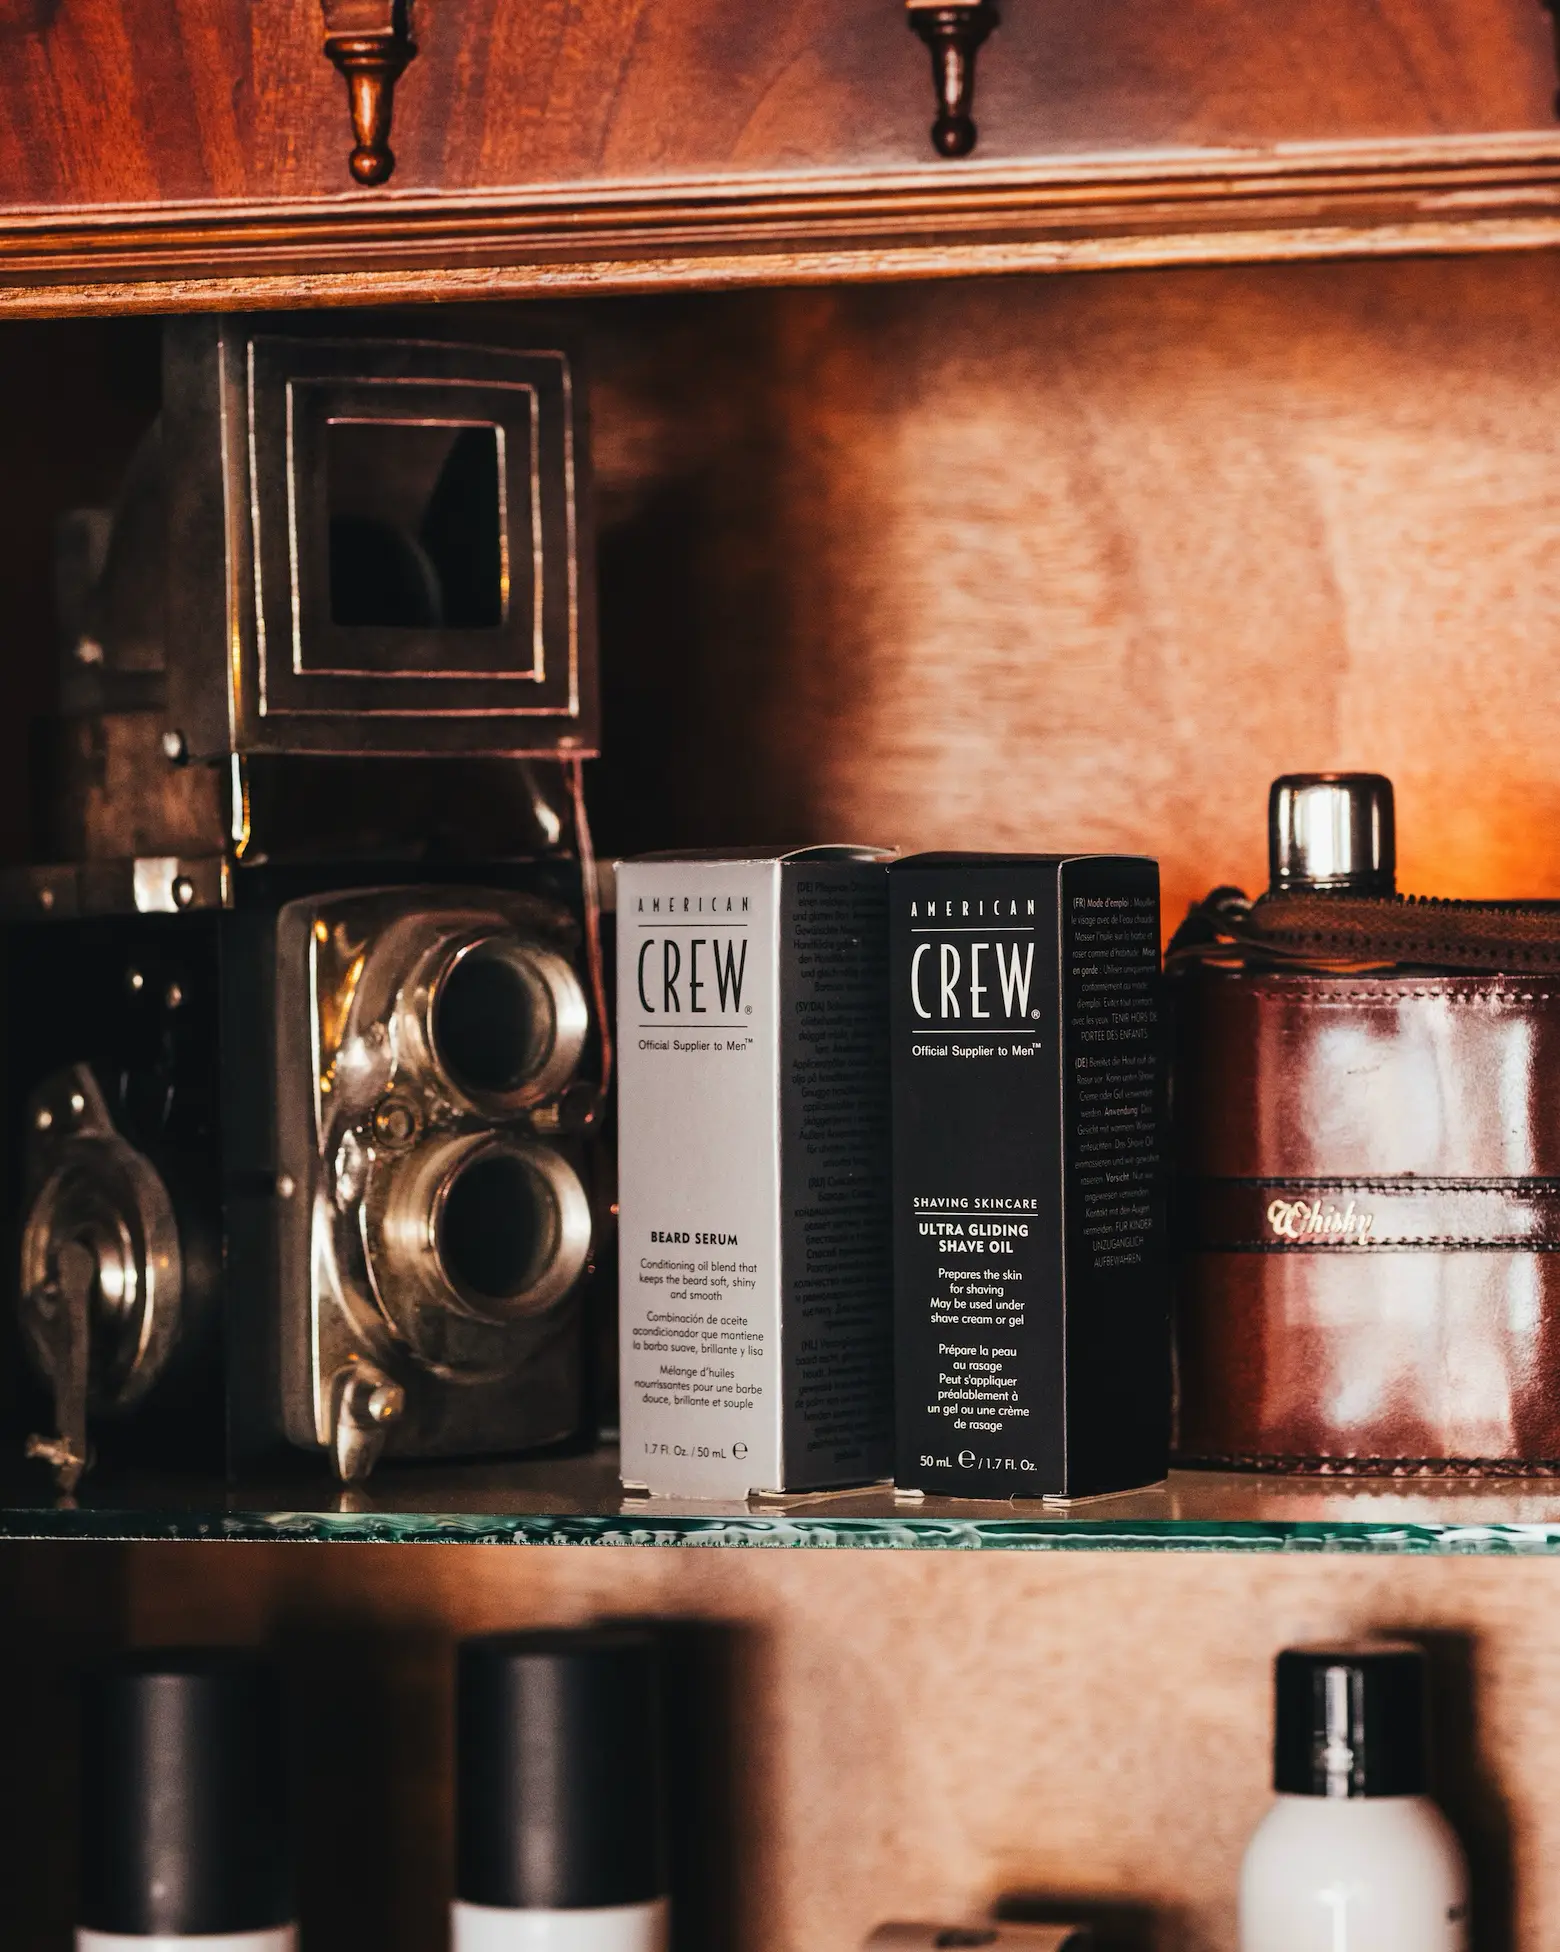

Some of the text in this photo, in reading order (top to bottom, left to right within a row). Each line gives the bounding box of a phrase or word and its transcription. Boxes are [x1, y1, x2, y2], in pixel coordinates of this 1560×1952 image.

[638, 897, 748, 912] AMERICAN
[911, 900, 1035, 916] AMERICAN
[639, 1040, 669, 1050] Official
[674, 1040, 709, 1052] Supplier
[714, 1042, 722, 1050] to
[912, 1046, 947, 1056] Official
[952, 1046, 993, 1058] Supplier
[998, 1047, 1008, 1056] to
[913, 1197, 1037, 1209] SHAVING SKINCARE
[1267, 1199, 1374, 1245] Whisky
[919, 1223, 1028, 1237] ULTRA GLIDING
[651, 1232, 738, 1245] BEARD SERUM
[939, 1240, 1013, 1253] SHAVE OIL
[640, 1258, 757, 1273] Conditioning oil blend that
[639, 1273, 756, 1289] keeps the beard soft, shiny
[939, 1268, 1022, 1281] Prepares the skin
[670, 1290, 722, 1301] and smooth
[950, 1284, 1004, 1297] for shaving
[930, 1298, 1025, 1310] May be used under
[647, 1311, 747, 1325] Combinación de aceite
[931, 1313, 1024, 1327] shave cream or gel
[633, 1327, 764, 1341] acondicionador que mantiene
[633, 1340, 763, 1357] la barba suave, brillante y lisa
[939, 1344, 1017, 1359] Prépare la peau
[660, 1365, 697, 1378] Mélange
[953, 1361, 1002, 1373] au rasage
[634, 1380, 762, 1395] nourrissantes pour une barbe
[939, 1374, 1017, 1388] Peut s'appliquer
[643, 1394, 753, 1410] douce, brillante et souple
[938, 1389, 1019, 1403] préalablement à
[928, 1404, 1030, 1416] un gel ou une crème
[954, 1419, 1003, 1432] de rasage
[698, 1446, 709, 1457] 50
[712, 1448, 726, 1458] mL
[920, 1456, 933, 1467] 50
[936, 1456, 952, 1467] mL
[986, 1458, 1001, 1470] 1.7
[1005, 1459, 1017, 1470] Fl.
[1021, 1459, 1038, 1471] Oz.
